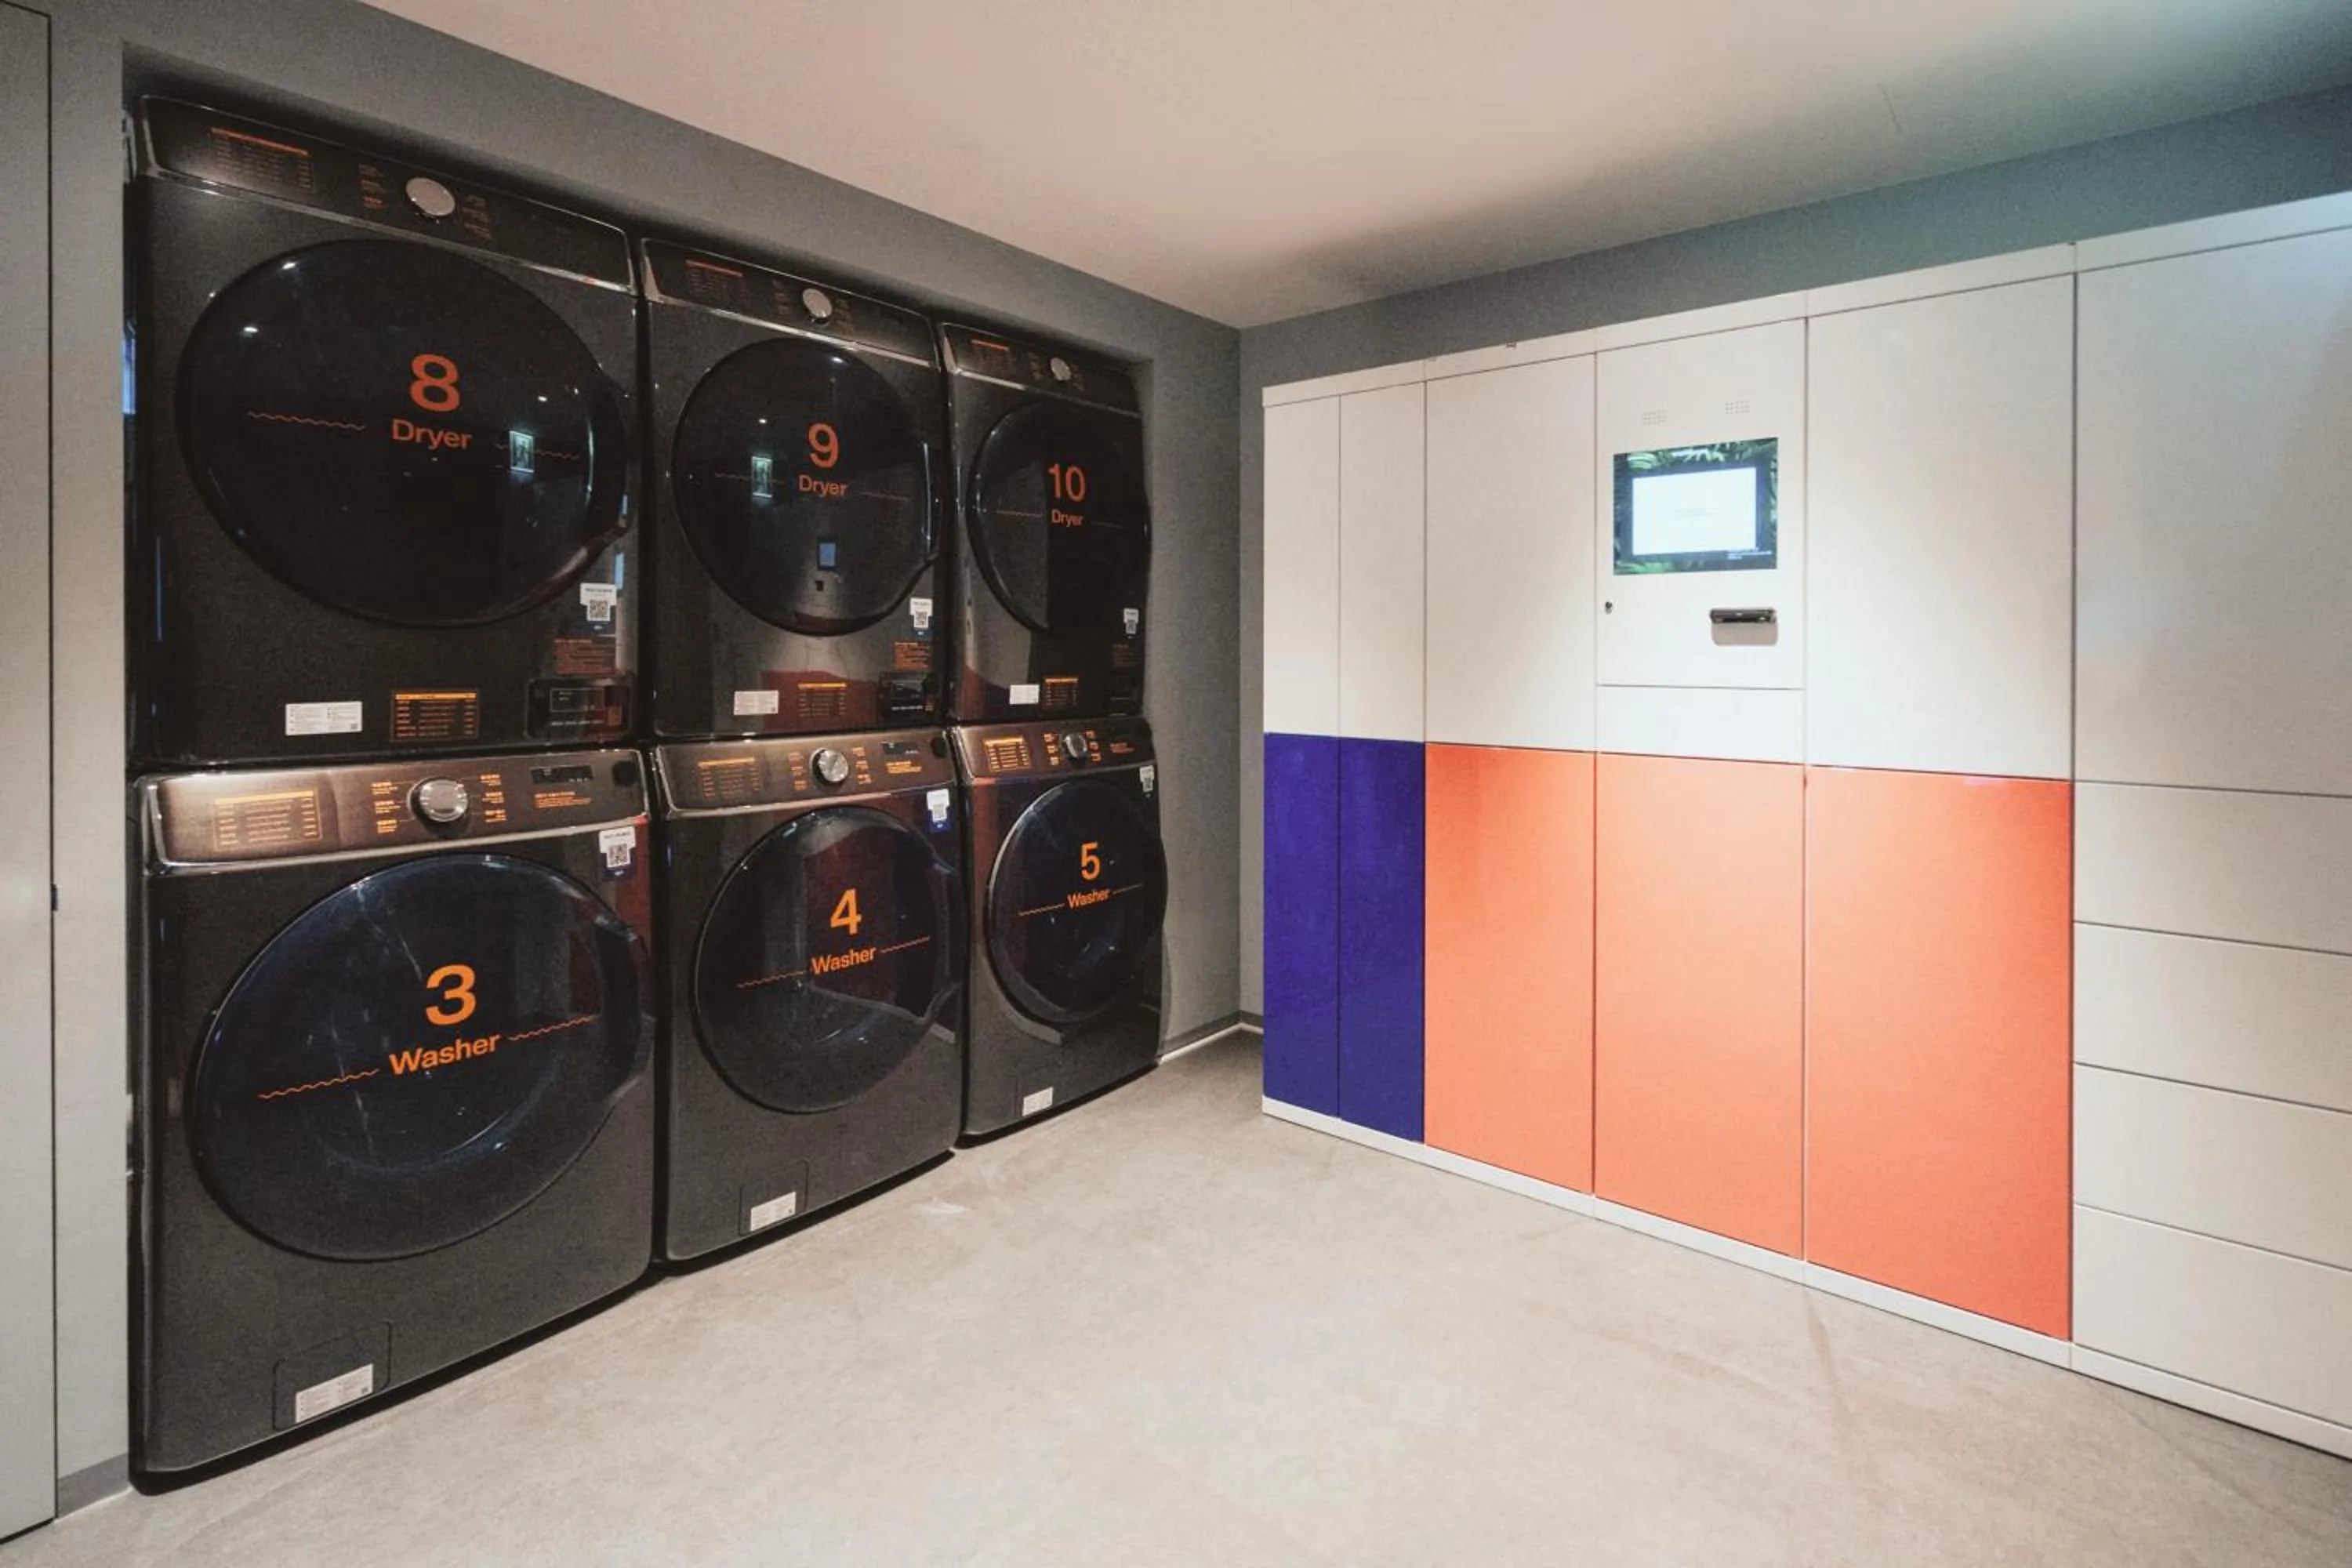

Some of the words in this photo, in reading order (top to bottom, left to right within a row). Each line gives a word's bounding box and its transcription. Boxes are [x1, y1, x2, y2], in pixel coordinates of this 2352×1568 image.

[410, 354, 459, 411] 8
[391, 418, 471, 450] Dryer
[808, 423, 839, 469] 9
[798, 475, 847, 498] Dryer
[1049, 463, 1086, 503] 10
[1051, 510, 1083, 527] Dryer
[1080, 842, 1101, 880] 5
[829, 889, 862, 935] 4
[1068, 889, 1110, 908] Washer
[812, 946, 877, 975] Washer
[426, 964, 476, 1025] 3
[390, 1034, 499, 1075] Washer
